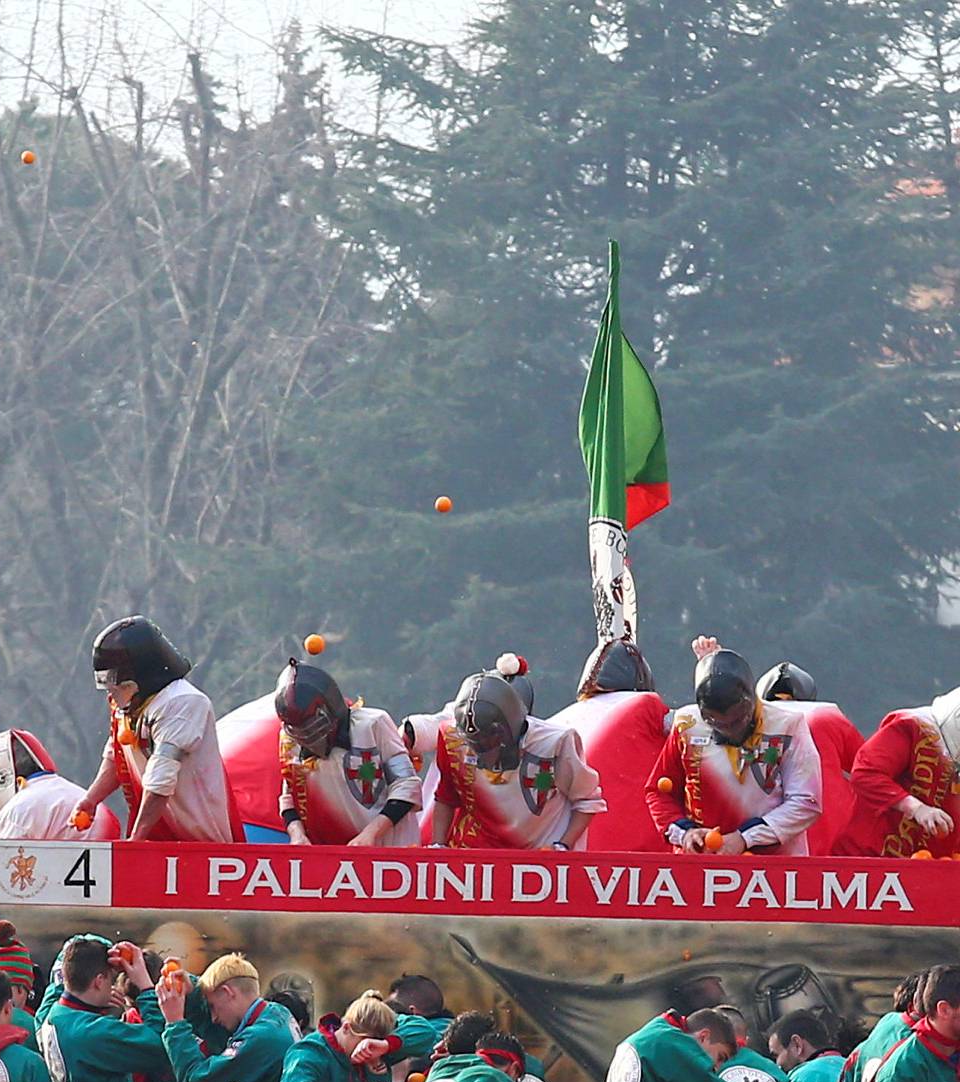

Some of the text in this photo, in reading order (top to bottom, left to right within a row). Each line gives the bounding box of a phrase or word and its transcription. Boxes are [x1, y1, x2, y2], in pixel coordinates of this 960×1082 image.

[64, 849, 96, 898] 4
[165, 856, 914, 912] I PALADINI DI VIA PALMA
